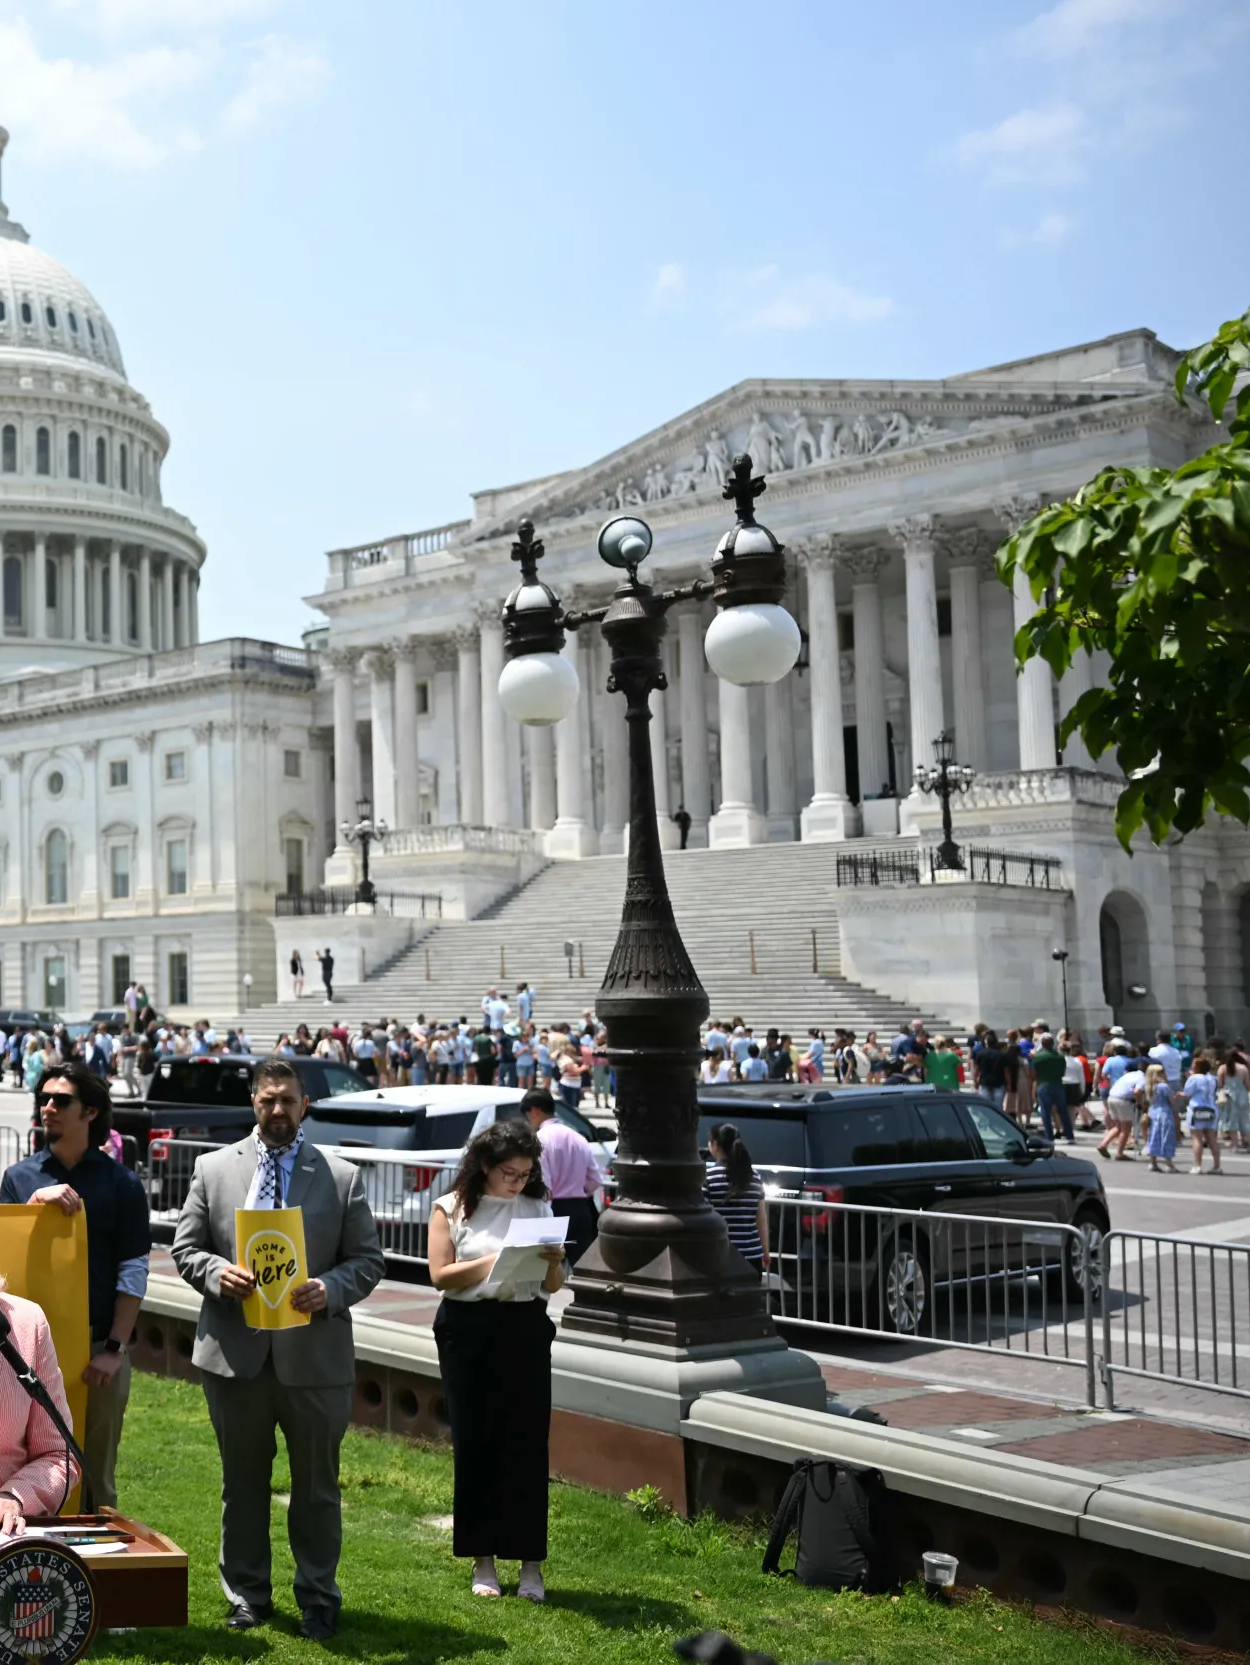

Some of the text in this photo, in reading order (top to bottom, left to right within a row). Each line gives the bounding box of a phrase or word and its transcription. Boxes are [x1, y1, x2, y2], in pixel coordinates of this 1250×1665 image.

[255, 1243, 286, 1254] HOME
[265, 1254, 275, 1262] IS
[252, 1258, 297, 1288] here
[55, 1580, 90, 1661] SENATE
